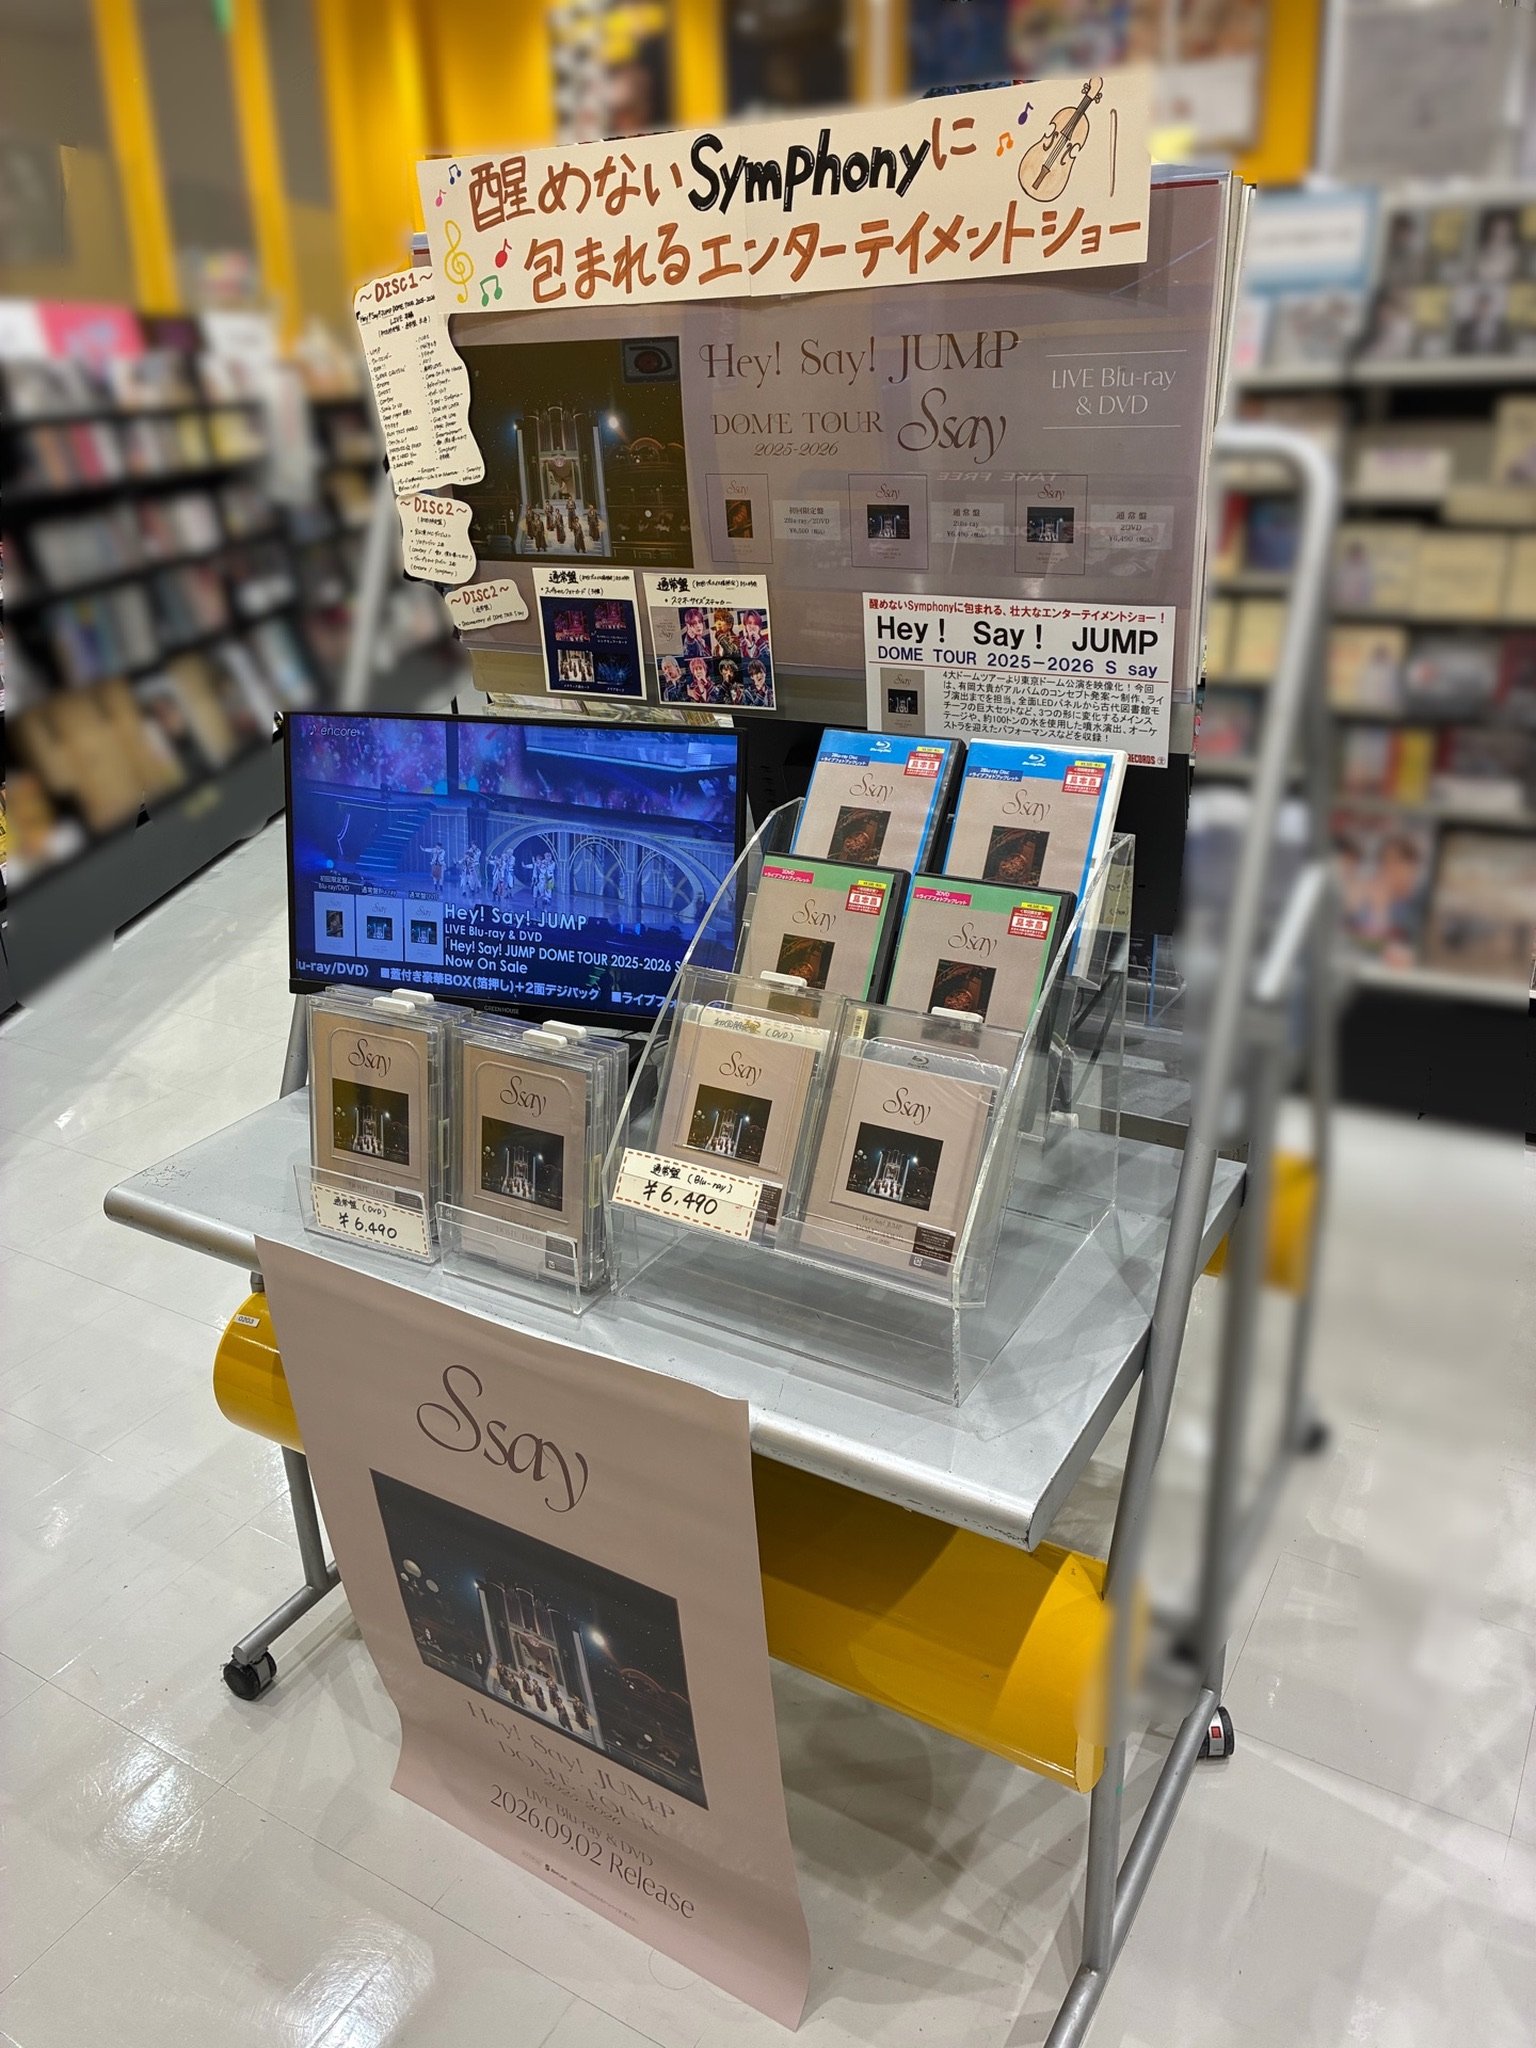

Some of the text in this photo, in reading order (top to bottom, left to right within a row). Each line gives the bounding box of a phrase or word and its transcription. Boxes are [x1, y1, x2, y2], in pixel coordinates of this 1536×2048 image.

[524, 200, 1141, 303] 包まれるエンターテイメントショー
[699, 330, 1019, 388] Hey! Say! JUMP
[1051, 365, 1177, 391] LIVE Blu-ray
[1076, 394, 1149, 416] & DVD
[711, 411, 884, 435] DOME TOUR
[753, 441, 840, 457] 2025-2026
[1072, 627, 1159, 655] JUMP
[878, 645, 923, 661] DOME
[933, 648, 977, 665] TOUR
[1105, 660, 1117, 675] S
[1128, 664, 1158, 679] say
[320, 726, 358, 737] encore
[444, 903, 587, 931] Hey! Say! JUMP
[445, 923, 543, 942] LIVE Blu-ray & DVD
[444, 954, 528, 974] Now On Sale
[478, 941, 502, 958] Say!
[504, 944, 536, 959] JUMP
[538, 948, 575, 963] DOME
[577, 951, 608, 966] TOUR
[610, 954, 672, 973] 2025-2026
[483, 1005, 520, 1015] GREENHOUSE
[687, 1173, 733, 1194] (Blu-ray)
[362, 1203, 387, 1218] (DVD)
[466, 1700, 676, 1818] Hey! Say! JUMP
[499, 1740, 575, 1789] DOME
[489, 1784, 603, 1866] 2026.09.02
[609, 1852, 695, 1919] Release
[606, 1832, 618, 1847] &
[621, 1840, 654, 1866] DVD
